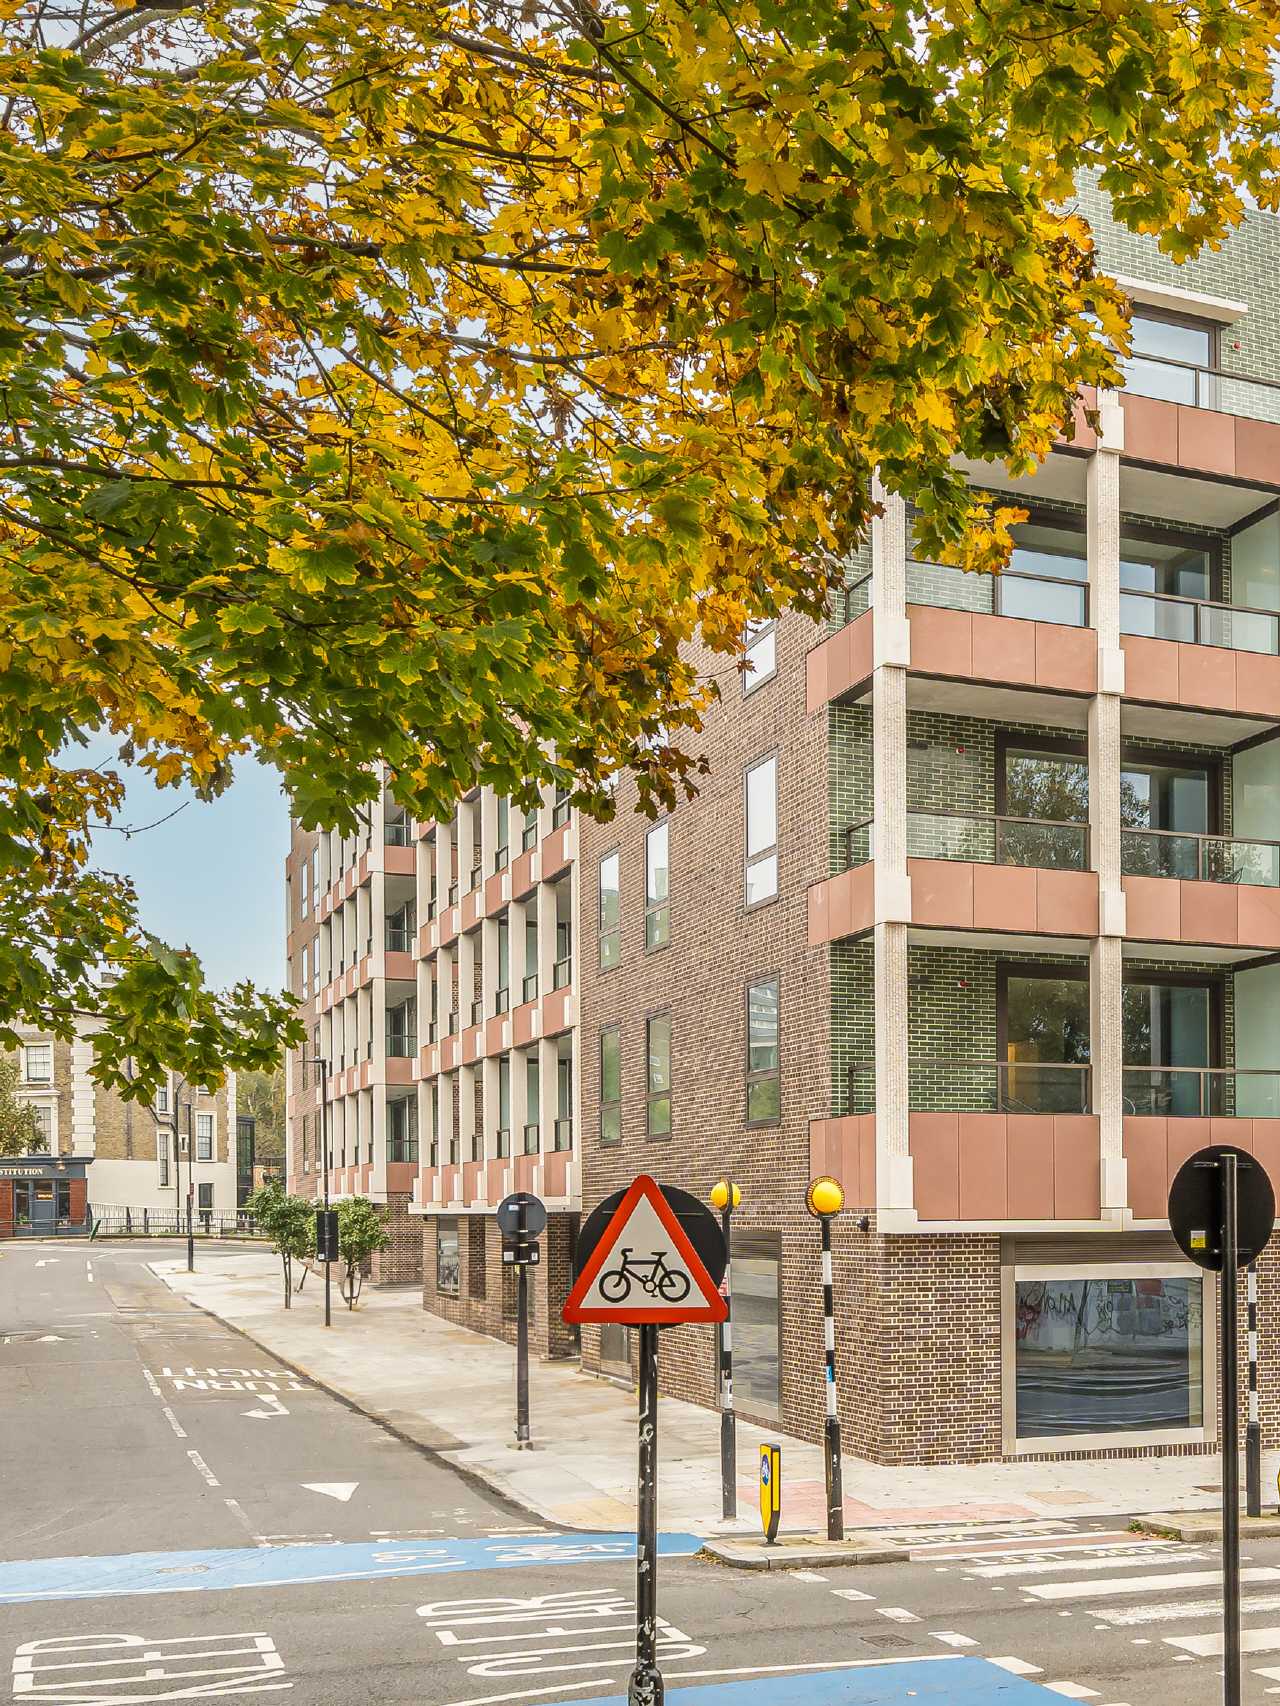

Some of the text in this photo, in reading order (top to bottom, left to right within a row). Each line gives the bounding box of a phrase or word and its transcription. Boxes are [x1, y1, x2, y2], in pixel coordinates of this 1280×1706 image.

[154, 1367, 302, 1380] RIGHT
[172, 1379, 318, 1391] TURN
[1083, 1545, 1176, 1557] LOOK
[415, 1588, 708, 1677] CLEAR
[11, 1632, 294, 1706] KEEP
